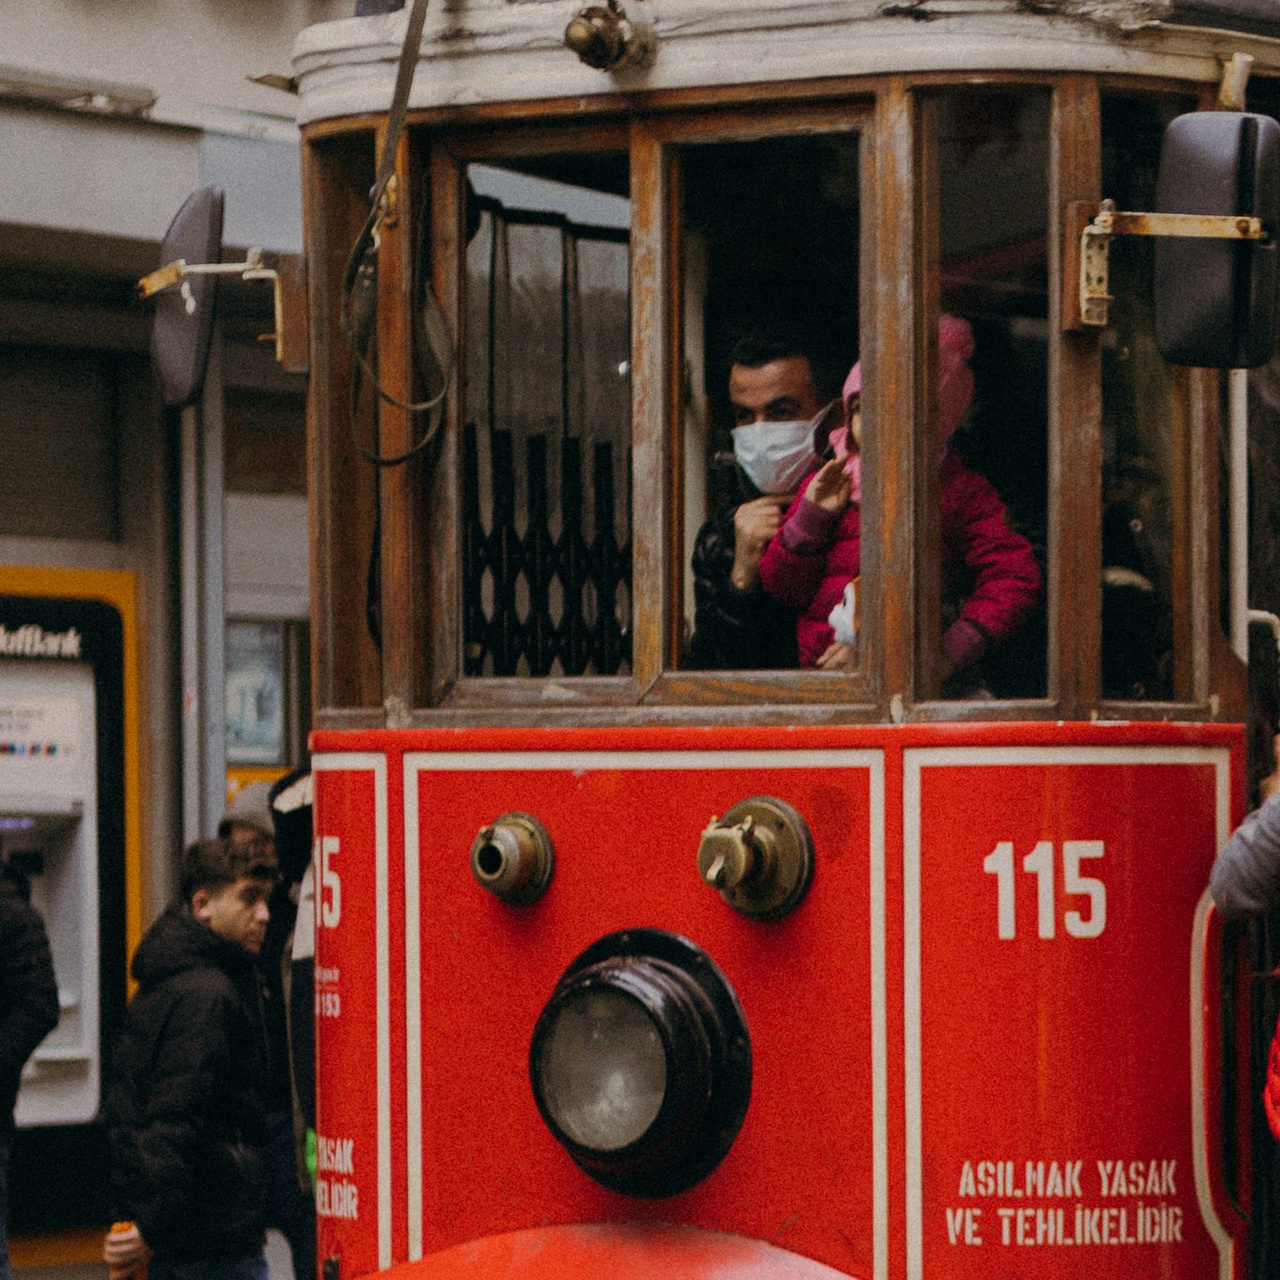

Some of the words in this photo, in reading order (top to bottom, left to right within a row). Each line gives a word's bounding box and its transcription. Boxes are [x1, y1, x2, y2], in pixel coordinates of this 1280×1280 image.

[982, 839, 1108, 941] 115
[958, 1159, 1084, 1198] ASILMAK
[1096, 1158, 1178, 1197] YASAK
[945, 1206, 984, 1247] VE
[997, 1200, 1184, 1247] TEHLİKELİDİR
